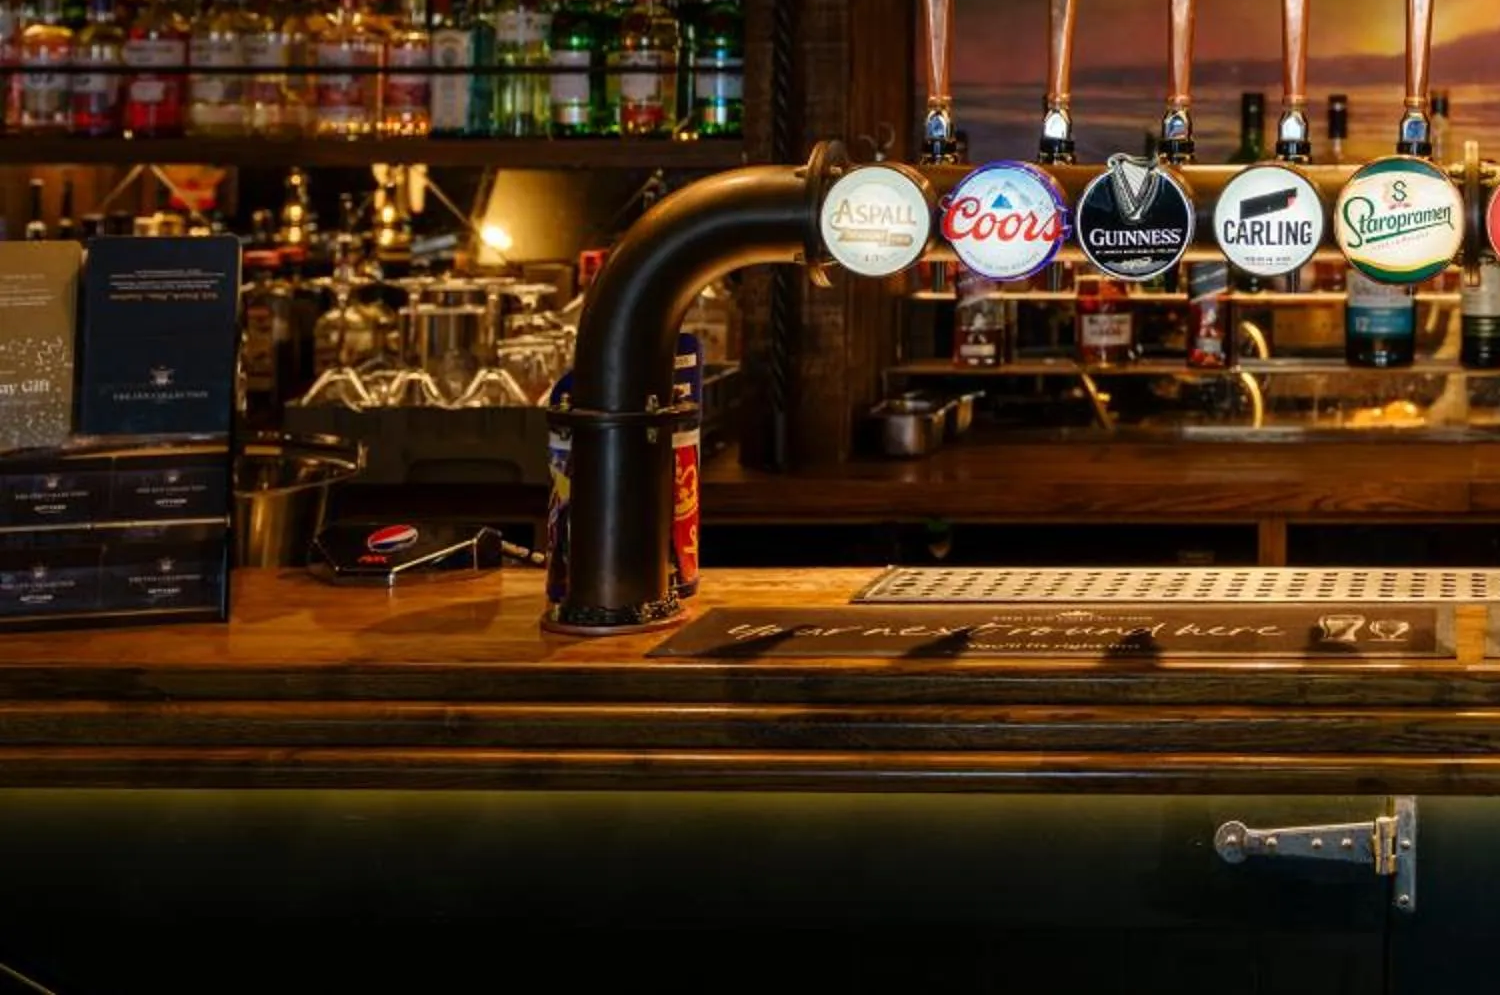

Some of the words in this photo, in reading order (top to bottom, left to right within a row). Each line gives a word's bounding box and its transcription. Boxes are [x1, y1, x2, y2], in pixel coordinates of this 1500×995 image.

[830, 198, 917, 227] ASPALL
[942, 195, 1062, 243] Coors
[1343, 196, 1454, 248] Staropramen
[1090, 227, 1181, 247] GUINNESS
[1224, 219, 1313, 247] CARLING
[1008, 622, 1166, 638] round
[1174, 623, 1286, 637] here
